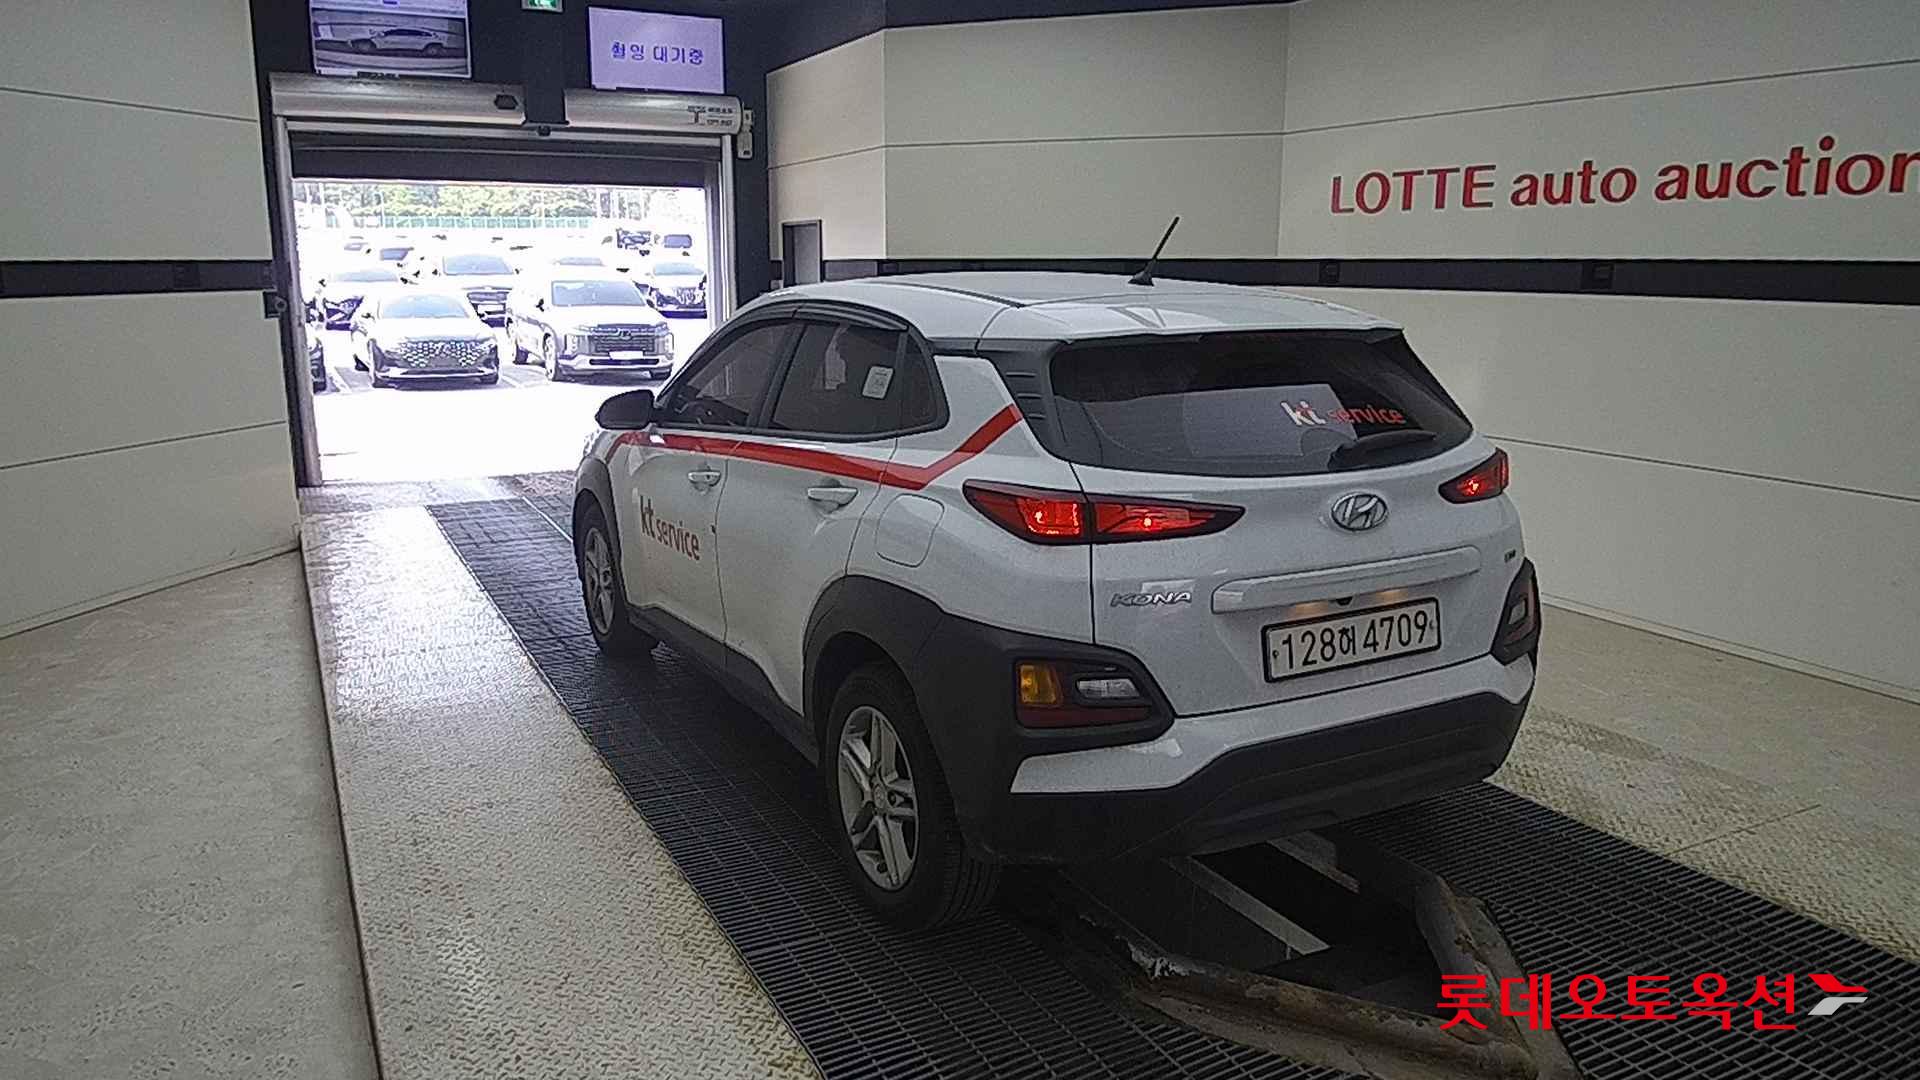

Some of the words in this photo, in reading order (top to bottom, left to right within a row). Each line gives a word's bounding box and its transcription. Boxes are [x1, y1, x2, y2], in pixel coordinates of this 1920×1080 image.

[1330, 164, 1496, 215] LOTTE
[1509, 160, 1638, 207] auto
[1328, 404, 1407, 424] service
[640, 494, 656, 539] kt
[655, 518, 700, 561] service
[1110, 592, 1193, 607] KONA
